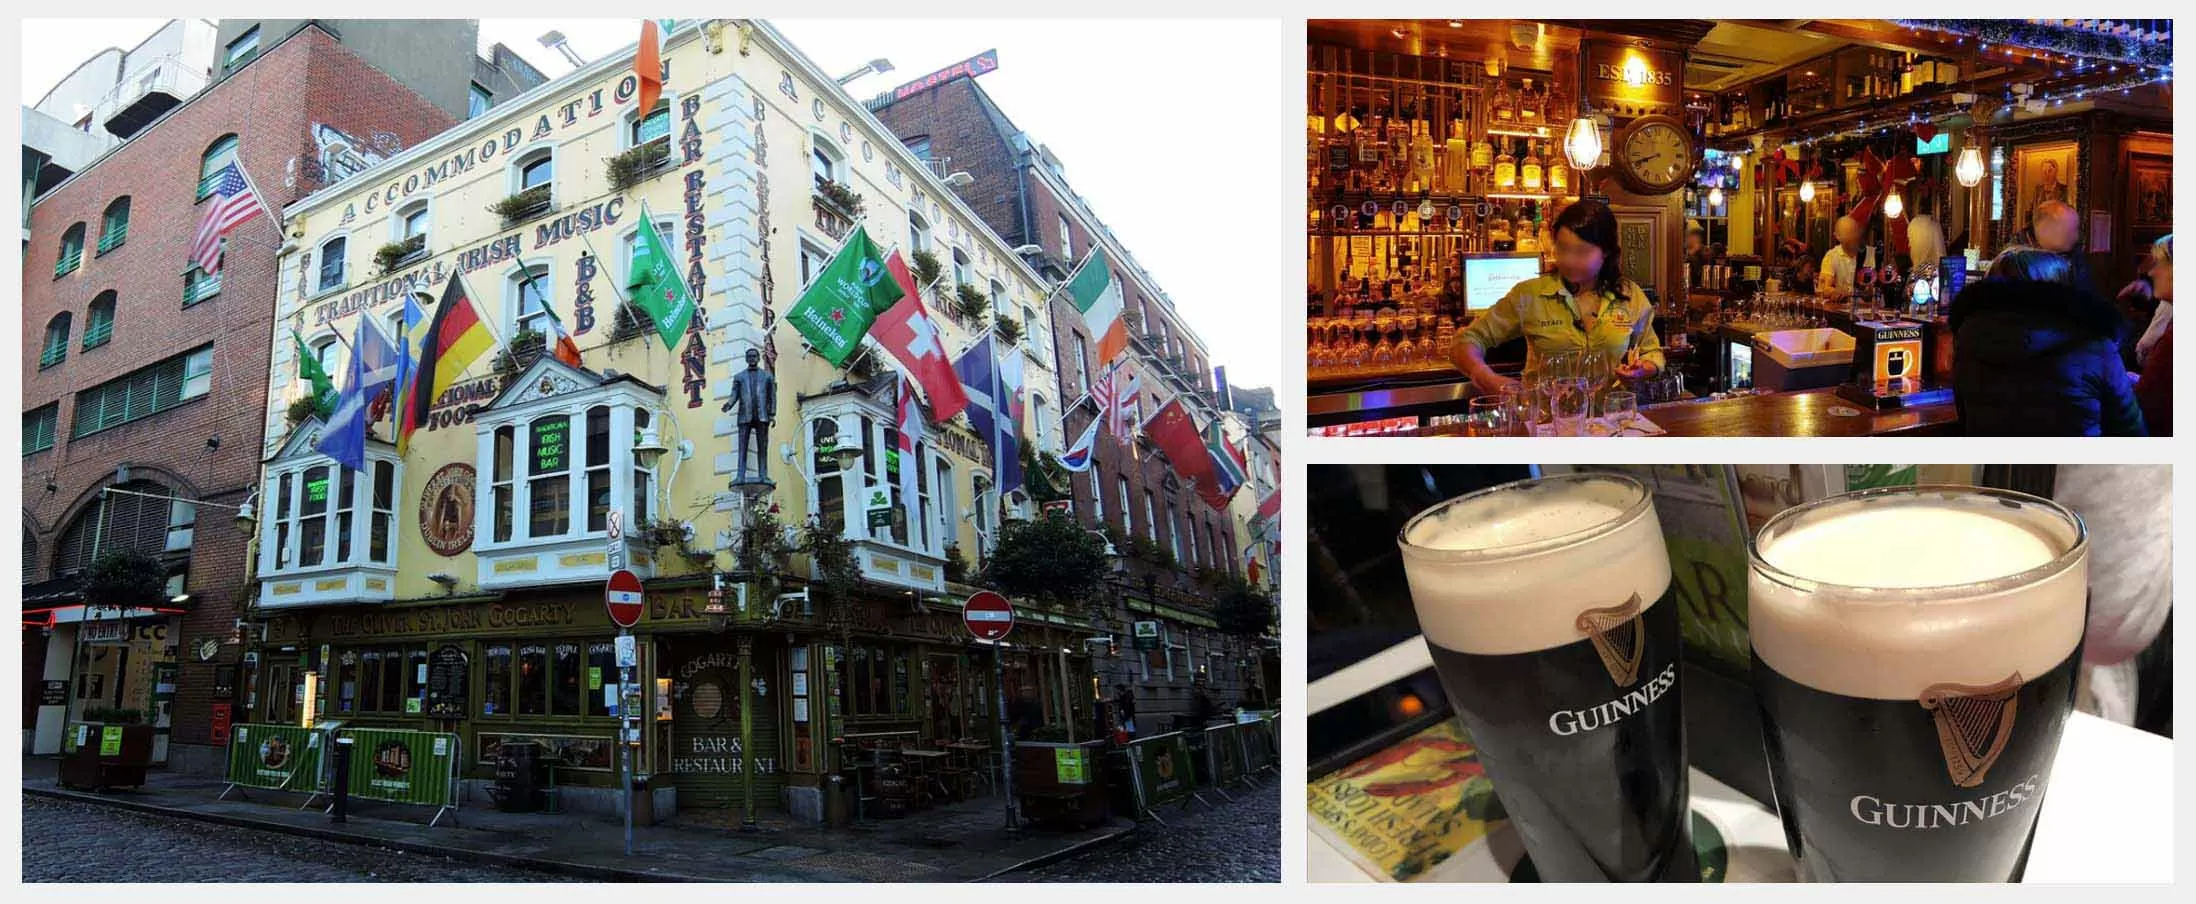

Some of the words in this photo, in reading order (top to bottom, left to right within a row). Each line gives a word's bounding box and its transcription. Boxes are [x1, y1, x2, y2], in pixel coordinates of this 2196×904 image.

[680, 94, 702, 168] BAR
[455, 232, 523, 274] IRISH
[533, 196, 625, 250] MUSIC
[573, 254, 598, 337] B&B
[803, 306, 846, 349] Heineken
[1877, 328, 1920, 340] GUINNESS
[536, 443, 563, 457] MUSIC
[540, 457, 559, 470] BAR
[487, 599, 577, 628] GOGARTY
[649, 584, 702, 620] BAR
[1548, 663, 1676, 737] GUINNESS
[672, 756, 777, 775] RESTAURNT
[691, 736, 729, 754] BAR
[729, 736, 743, 754] &
[1849, 773, 2041, 829] GUINNESS
